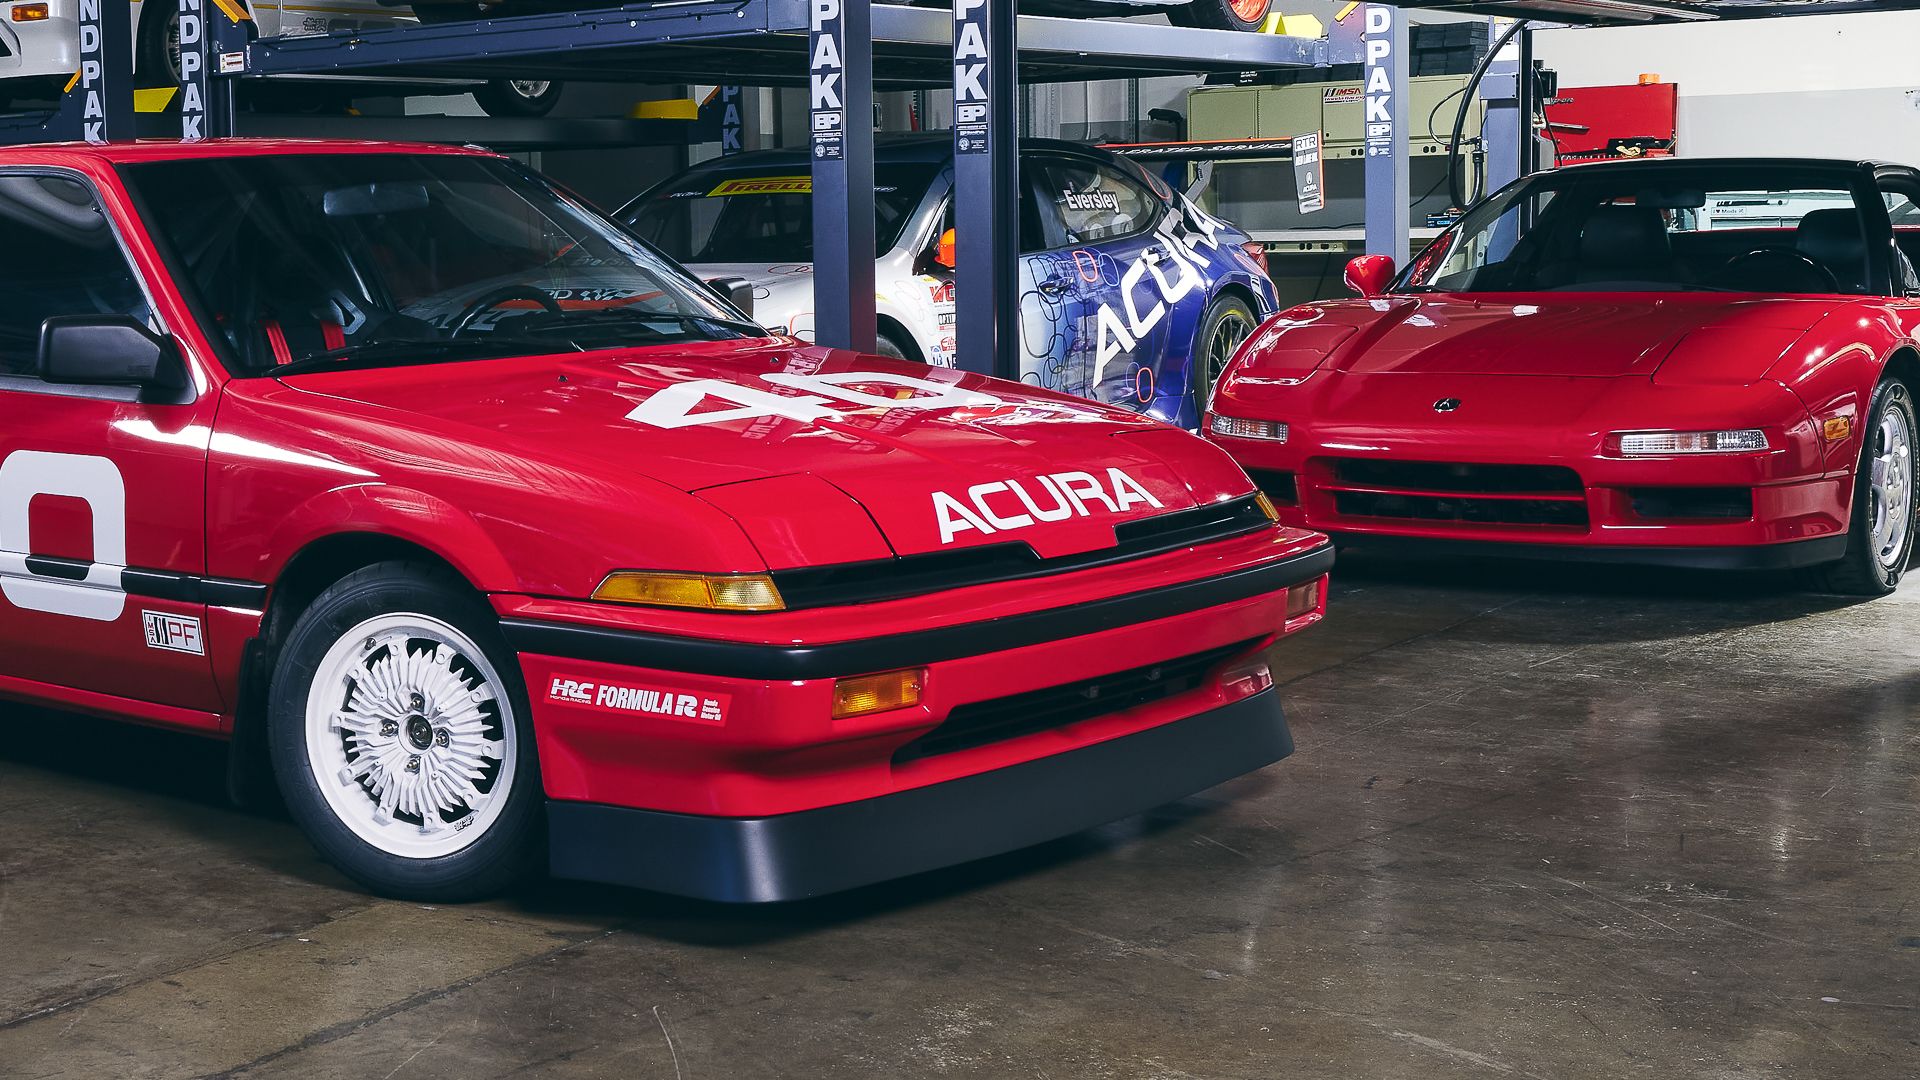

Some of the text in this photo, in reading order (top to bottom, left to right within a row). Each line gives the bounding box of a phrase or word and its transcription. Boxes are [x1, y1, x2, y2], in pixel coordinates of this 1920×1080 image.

[811, 0, 842, 108] PAK
[1366, 2, 1392, 121] DPAK
[1336, 88, 1361, 96] IMSA
[1296, 136, 1316, 150] RTR
[1064, 189, 1120, 214] Eversley
[1093, 192, 1225, 389] ACURA
[624, 372, 1003, 428] 40
[931, 467, 1164, 544] ACURA
[168, 621, 196, 646] PF
[551, 678, 697, 718] HRC FORMULA R
